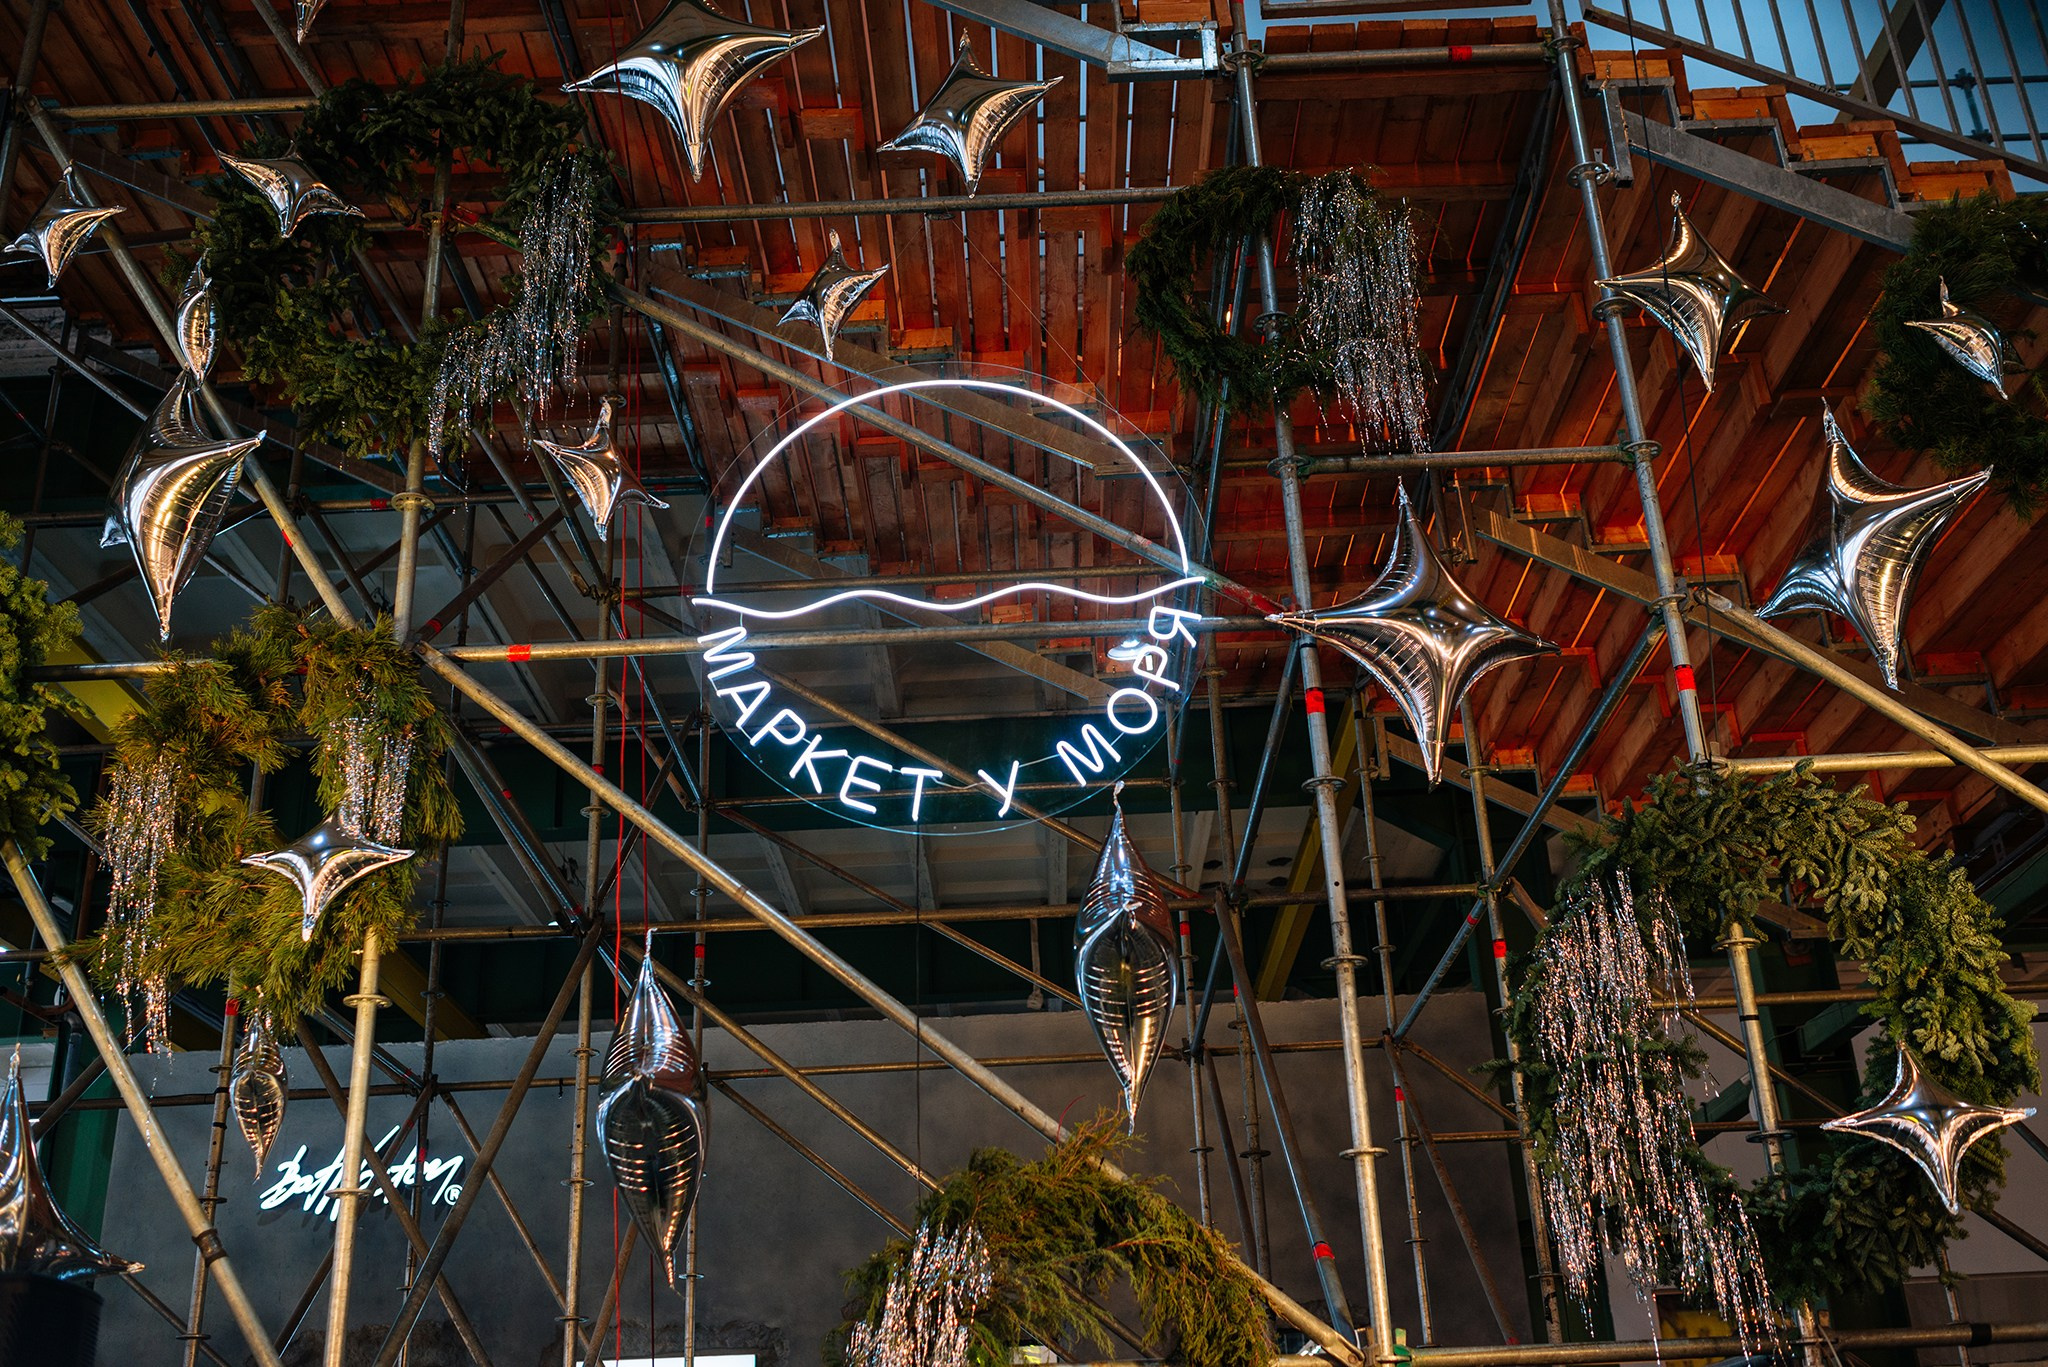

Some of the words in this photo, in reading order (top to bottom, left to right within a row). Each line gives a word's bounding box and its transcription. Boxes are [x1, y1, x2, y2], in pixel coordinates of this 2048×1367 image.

[697, 626, 943, 822] МАРКЕТ
[977, 760, 1020, 818] У
[1056, 605, 1202, 787] МОРЯ
